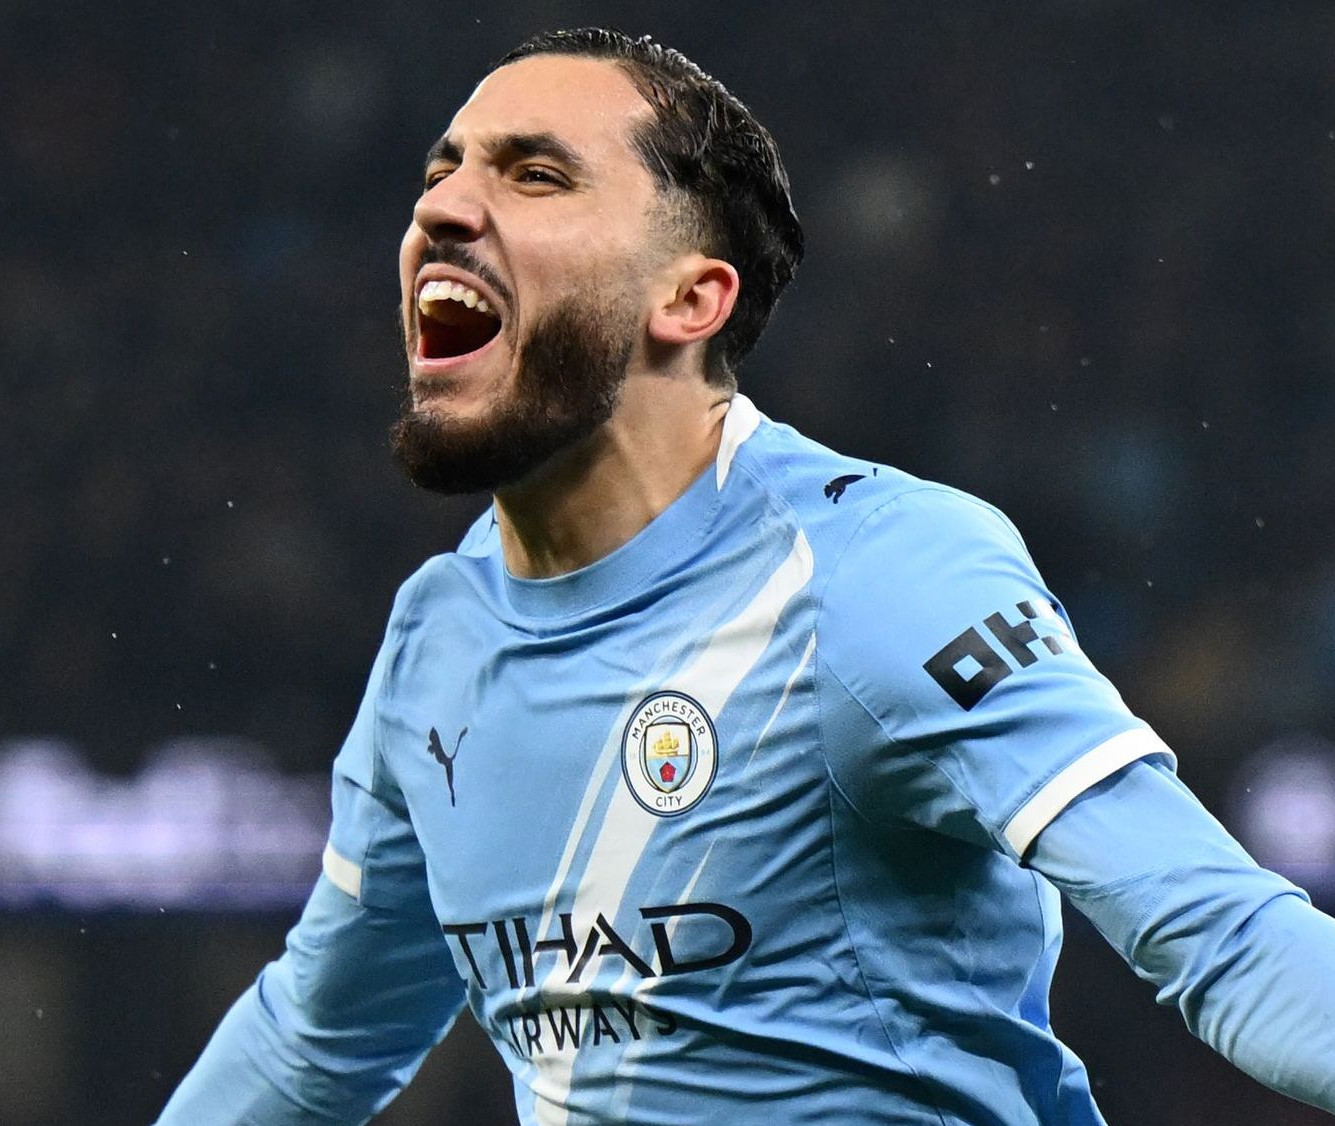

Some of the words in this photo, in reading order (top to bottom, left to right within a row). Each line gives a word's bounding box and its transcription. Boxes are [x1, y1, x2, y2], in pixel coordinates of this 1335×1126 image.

[922, 599, 1065, 712] OK
[632, 701, 706, 741] MANCHESTER
[655, 795, 683, 807] CITY
[442, 902, 753, 989] TIHAD
[506, 996, 678, 1057] IRWAYS
